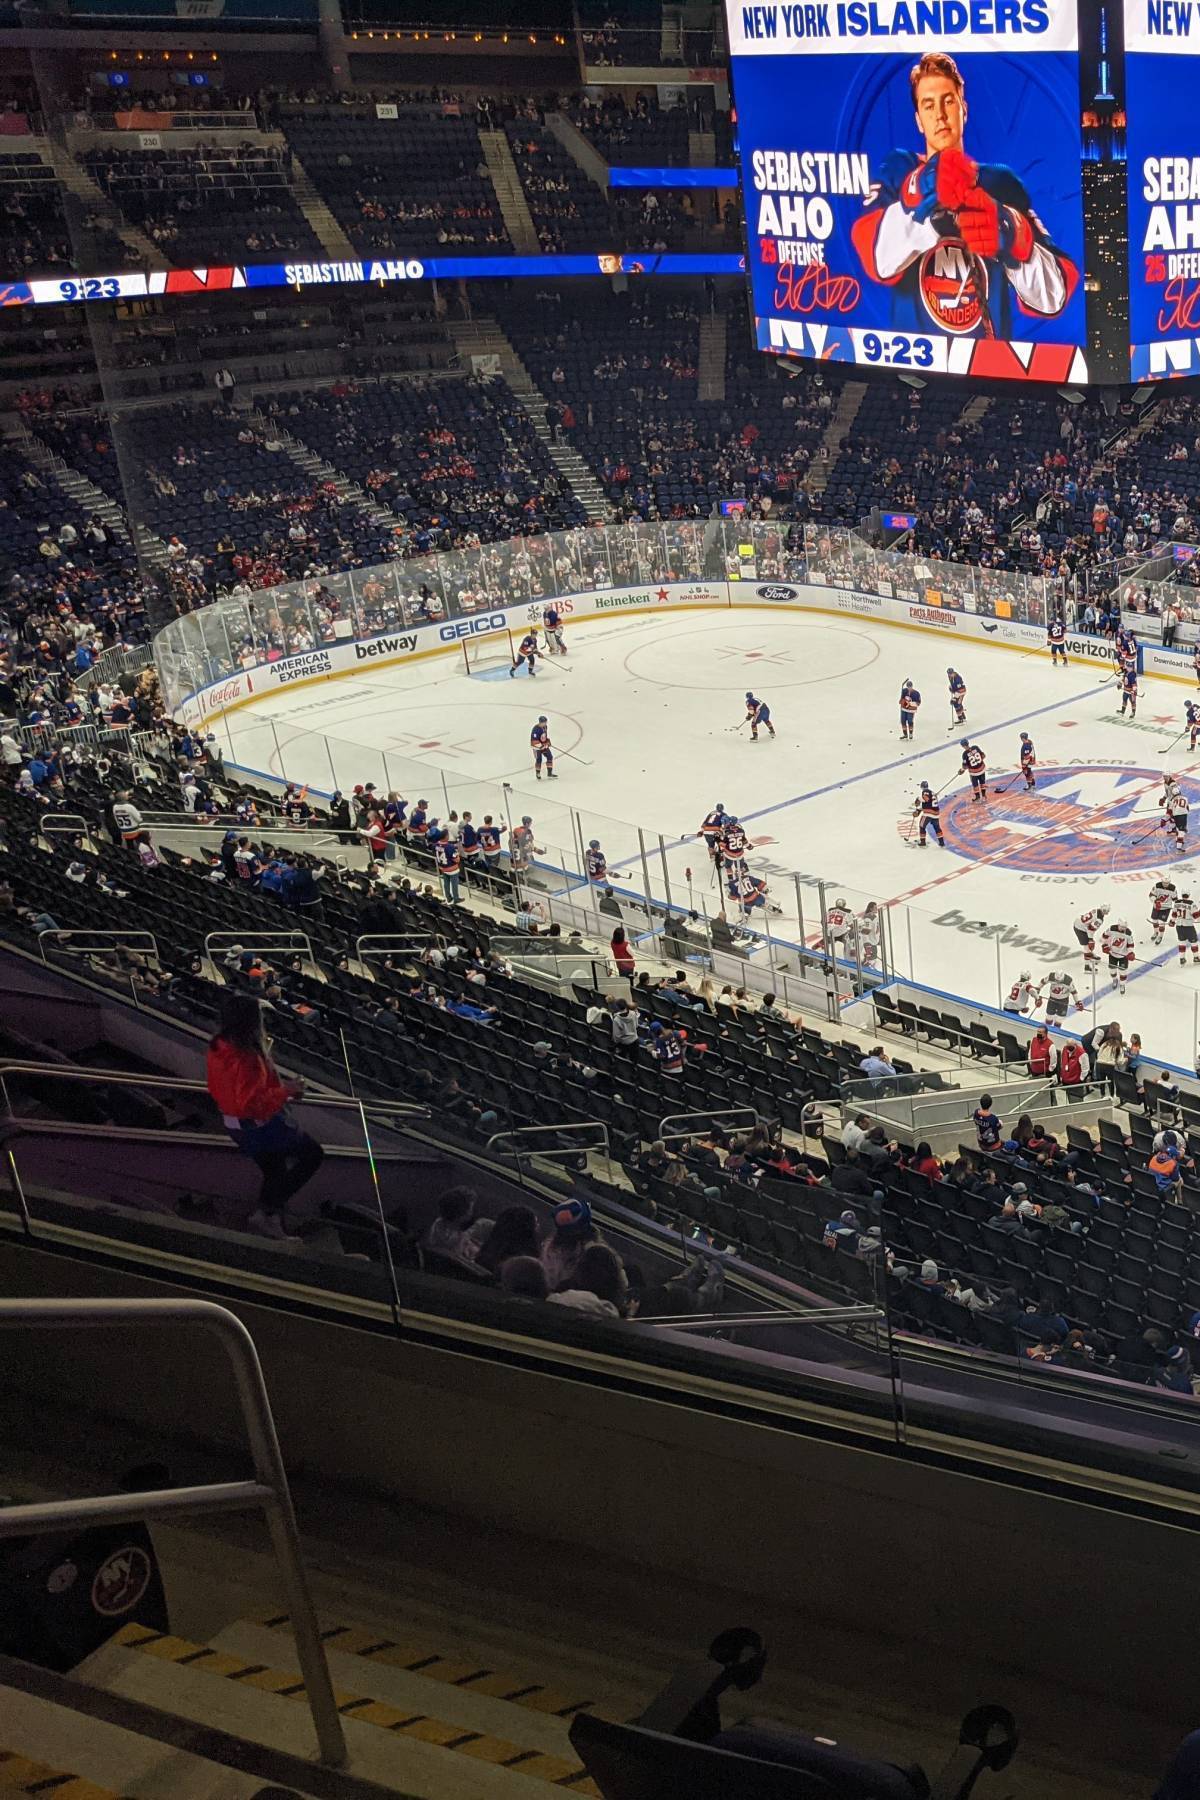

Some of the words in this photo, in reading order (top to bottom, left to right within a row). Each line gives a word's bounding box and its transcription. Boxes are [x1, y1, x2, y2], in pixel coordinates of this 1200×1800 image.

[743, 6, 776, 39] NEW
[783, 5, 830, 37] YORK
[837, 0, 1049, 36] ISLANDERS
[1147, 1, 1192, 36] NEW
[752, 151, 869, 195] SEBASTIAN
[758, 195, 833, 240] AHO
[760, 239, 777, 264] 25
[777, 241, 826, 266] DEFENSE
[285, 262, 365, 284] SEBASTIAN
[369, 260, 423, 280] AHO
[1145, 255, 1166, 283] 25
[59, 278, 121, 298] 9:23
[863, 333, 933, 367] 9:23
[595, 593, 650, 609] Heineken
[764, 586, 791, 599] Ford
[439, 614, 506, 641] GEICO
[1052, 626, 1063, 637] 27
[355, 634, 418, 659] betway
[1064, 639, 1117, 659] verizon
[269, 652, 329, 675] AMERICAN
[279, 662, 332, 683] EXPRESS
[1153, 656, 1183, 668] Download
[968, 753, 982, 766] 29
[1069, 757, 1137, 766] Arena
[729, 837, 743, 850] 26
[932, 909, 1084, 963] betway
[666, 1045, 680, 1058] 13
